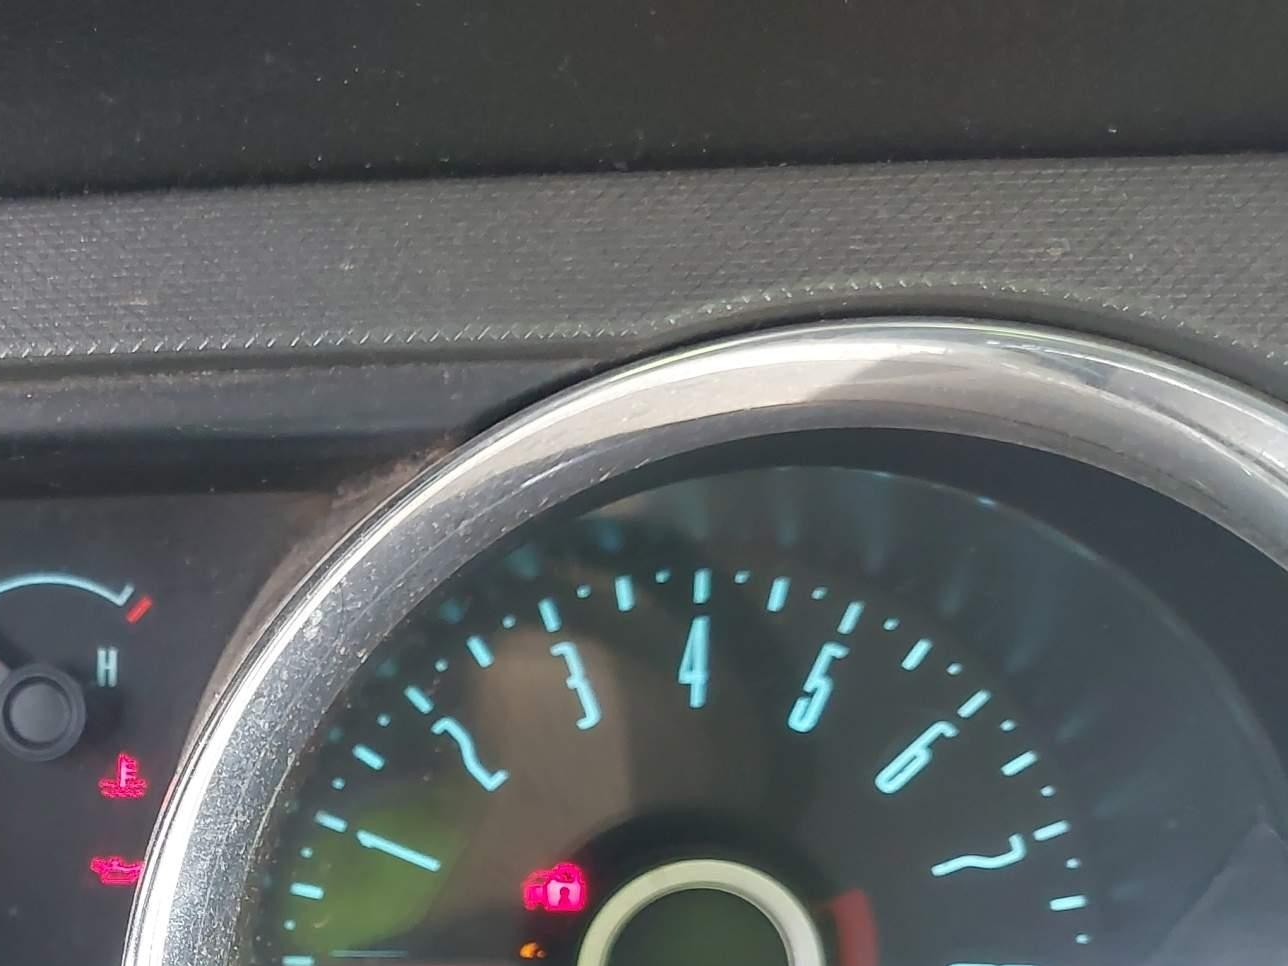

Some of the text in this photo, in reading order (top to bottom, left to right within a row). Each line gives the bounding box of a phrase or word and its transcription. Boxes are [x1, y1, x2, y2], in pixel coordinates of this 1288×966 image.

[97, 646, 119, 687] H
[551, 643, 601, 729] 3
[678, 616, 710, 708] 4
[788, 643, 850, 733] 5
[432, 716, 510, 792] 2
[875, 720, 958, 795] 6
[357, 829, 441, 872] 1
[931, 834, 1027, 877] 7
